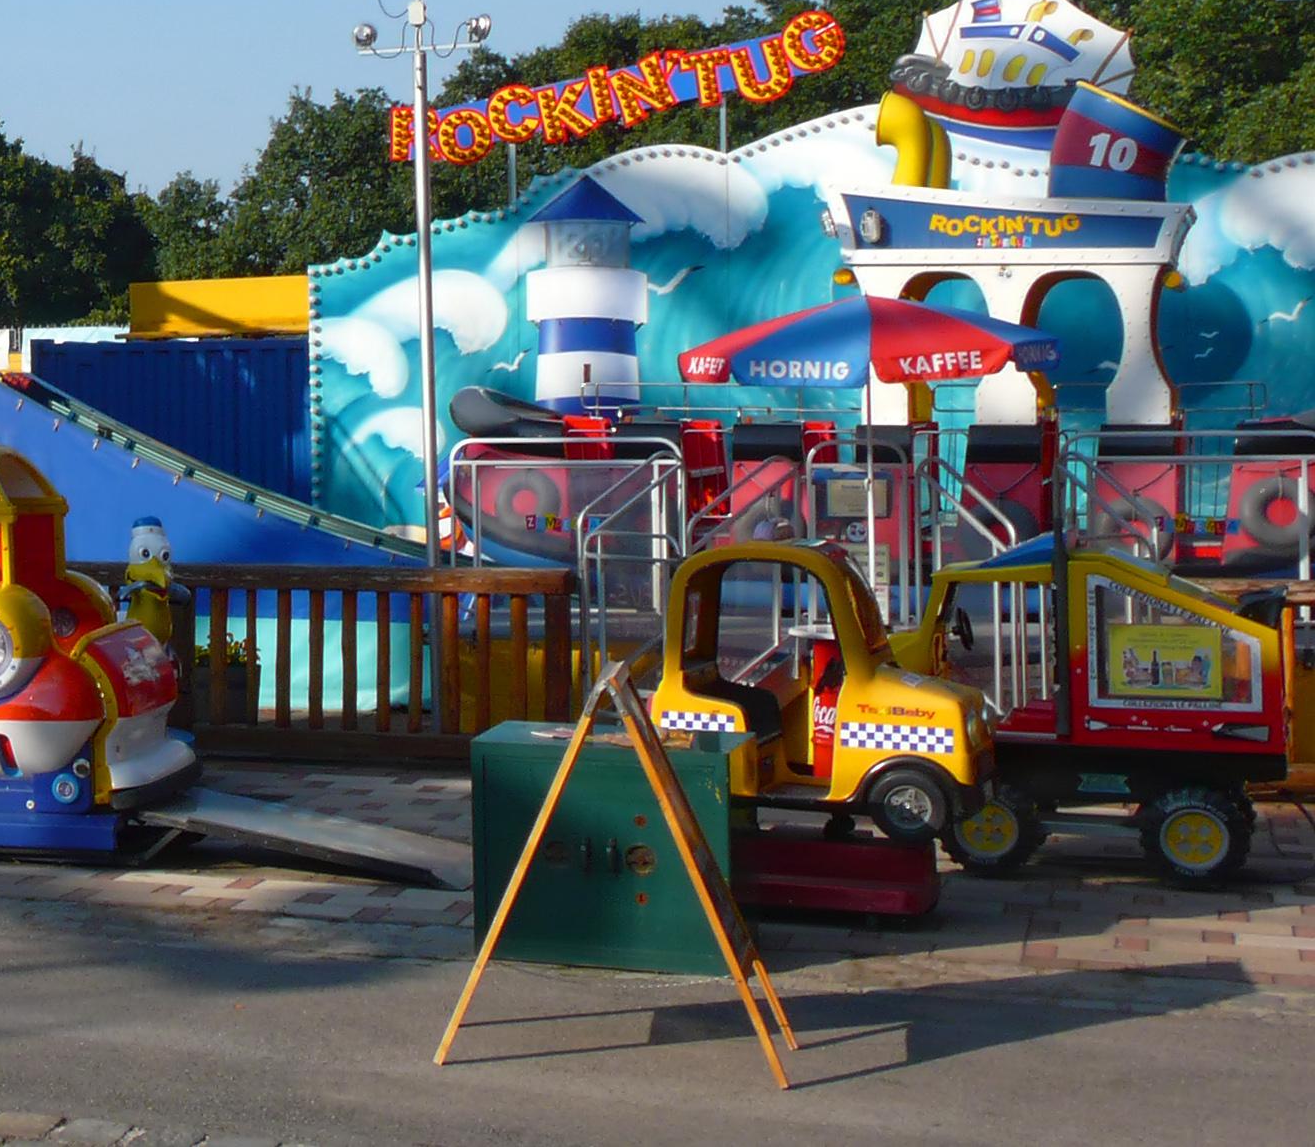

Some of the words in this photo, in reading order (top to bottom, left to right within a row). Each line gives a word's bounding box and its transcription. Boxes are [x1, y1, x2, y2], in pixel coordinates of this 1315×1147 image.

[390, 10, 846, 165] ROCKIN'TUG
[1088, 132, 1138, 172] 10
[929, 213, 1081, 238] ROCKIN'TUG
[749, 360, 851, 381] HORNIG
[899, 349, 983, 376] KAFFEE
